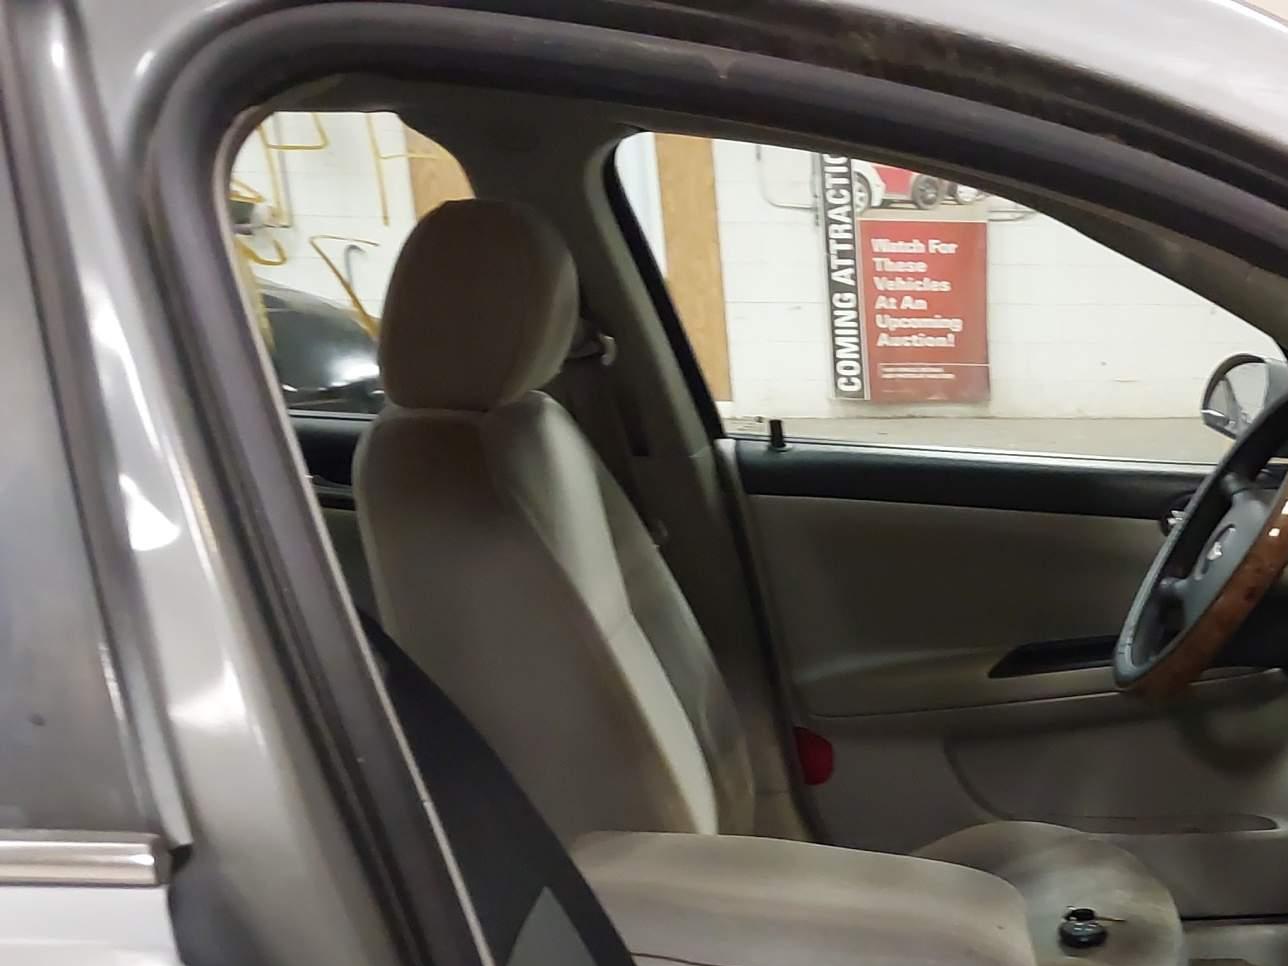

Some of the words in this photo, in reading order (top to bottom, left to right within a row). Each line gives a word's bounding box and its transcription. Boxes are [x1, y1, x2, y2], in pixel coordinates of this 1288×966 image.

[871, 238, 926, 254] Watch
[927, 239, 959, 254] For
[872, 257, 928, 273] These
[873, 276, 952, 293] Vehicles
[875, 295, 897, 310] At
[900, 295, 928, 310] An
[875, 314, 963, 332] Upcoming
[833, 292, 862, 392] COMING
[876, 333, 956, 348] Auction!
